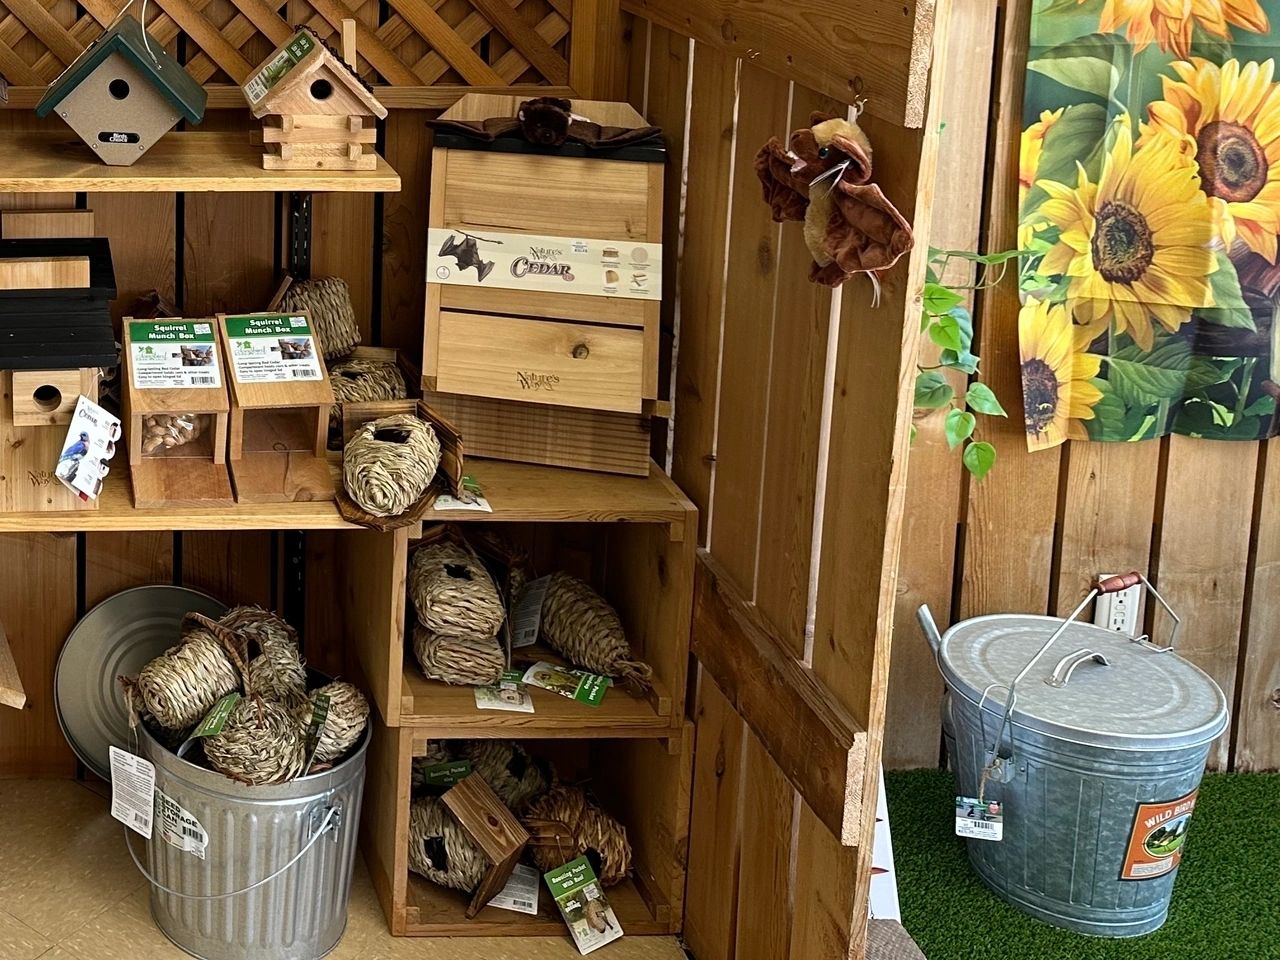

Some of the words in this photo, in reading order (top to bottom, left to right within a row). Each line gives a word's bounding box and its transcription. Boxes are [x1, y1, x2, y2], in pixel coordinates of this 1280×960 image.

[249, 319, 283, 327] Squirrel
[516, 371, 560, 384] Nature's
[161, 795, 181, 813] SEED
[161, 802, 198, 828] STORAGE
[161, 808, 178, 825] CAN
[1144, 809, 1172, 828] WILD
[1174, 801, 1191, 815] BIRD
[551, 871, 573, 884] Roosting
[572, 863, 587, 874] Pocket
[561, 879, 574, 889] With
[573, 874, 585, 883] Roof
